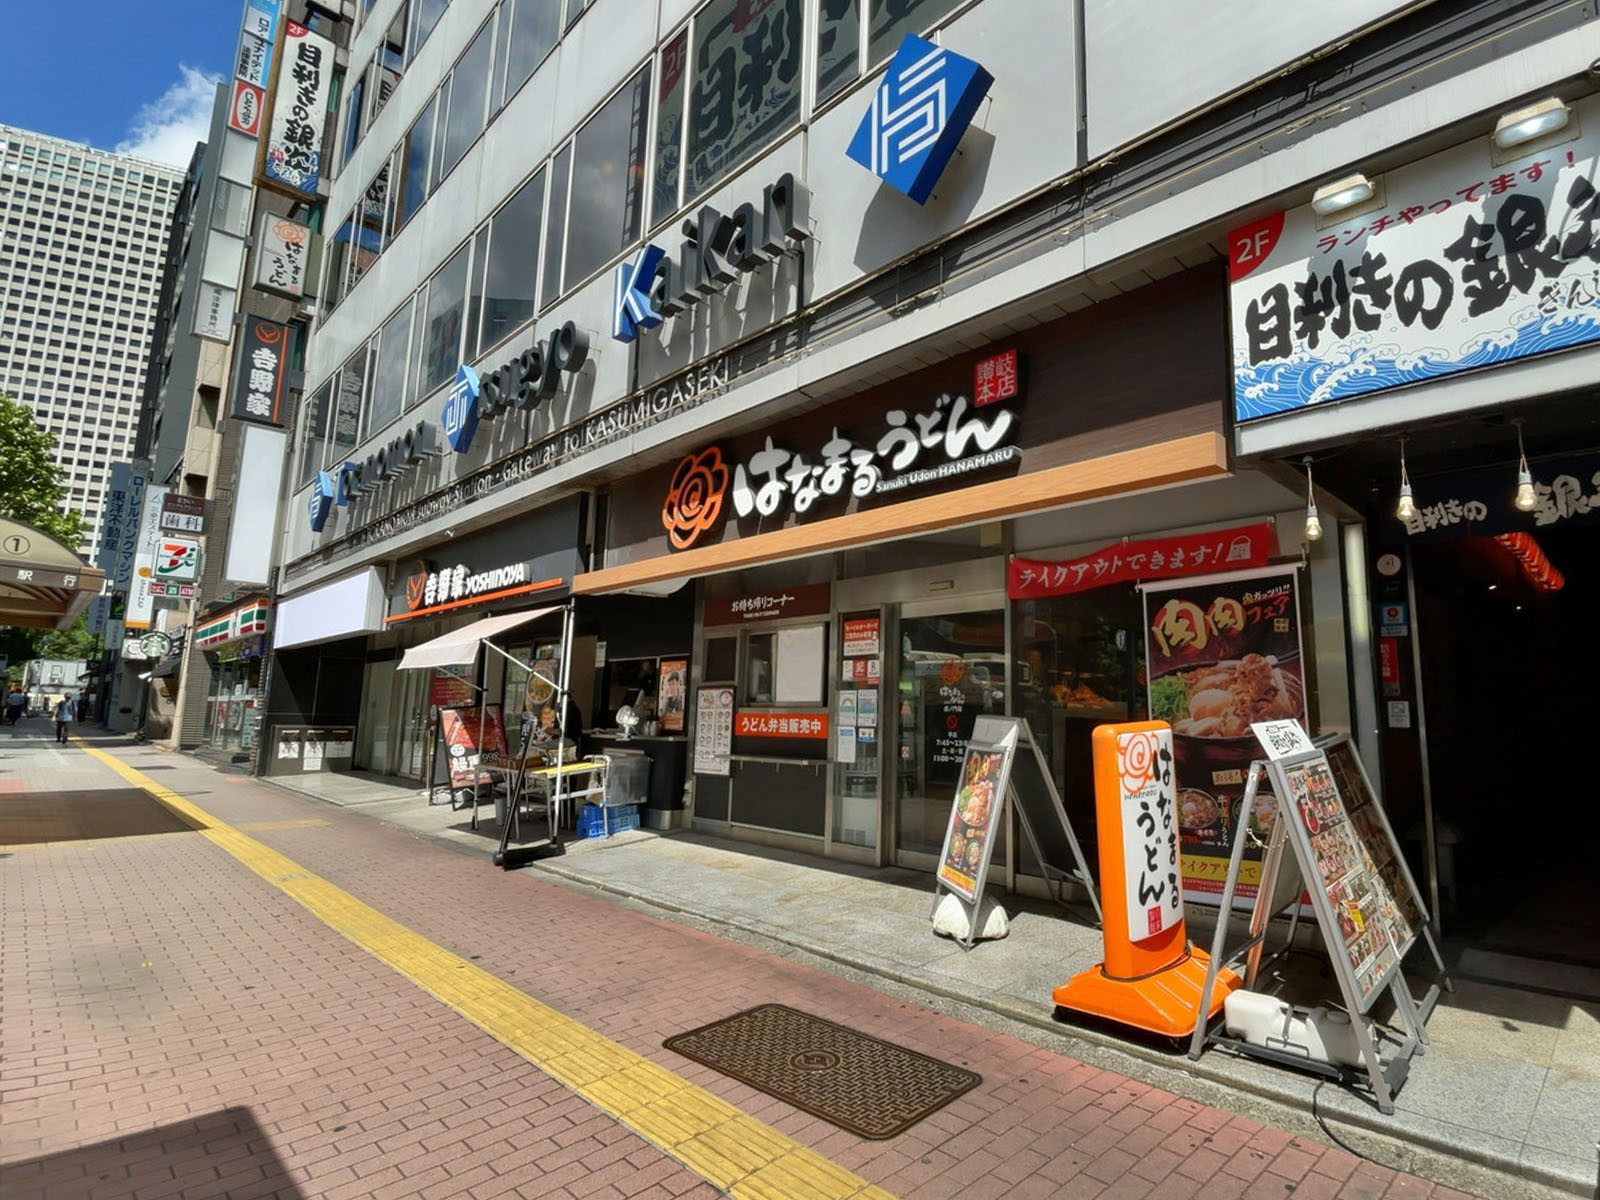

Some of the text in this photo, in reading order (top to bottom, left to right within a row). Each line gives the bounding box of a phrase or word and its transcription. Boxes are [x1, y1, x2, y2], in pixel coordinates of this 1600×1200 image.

[290, 23, 305, 35] 2F
[284, 42, 322, 174] 目利きの銀次
[285, 241, 304, 285] はなまる
[612, 172, 815, 342] Kaikan
[1236, 229, 1270, 264] 2F
[269, 257, 288, 287] うどん
[246, 346, 278, 416] 吉野家
[977, 374, 1015, 403] 本店
[564, 434, 580, 453] to
[585, 359, 729, 442] KASUMIGASEKI
[733, 394, 1012, 517] はなまるうどん
[876, 447, 1014, 492] Sanuki Udon HANAMARU
[104, 490, 127, 552] 東洋不動産
[118, 476, 144, 584] ローレルバンクマシン
[166, 514, 200, 530] 歯科
[1405, 499, 1488, 535] 目利きの
[424, 563, 525, 606] 吉野家 YOSHINOYA
[1019, 543, 1224, 590] テイクアウトできます!
[731, 594, 795, 612] お持ち帰りコーナー
[1246, 595, 1290, 624] フェア
[742, 716, 821, 734] うどん弁当販売中
[1153, 742, 1180, 909] はなまる
[1136, 801, 1165, 906] うどん
[1180, 860, 1256, 879] イクアで
